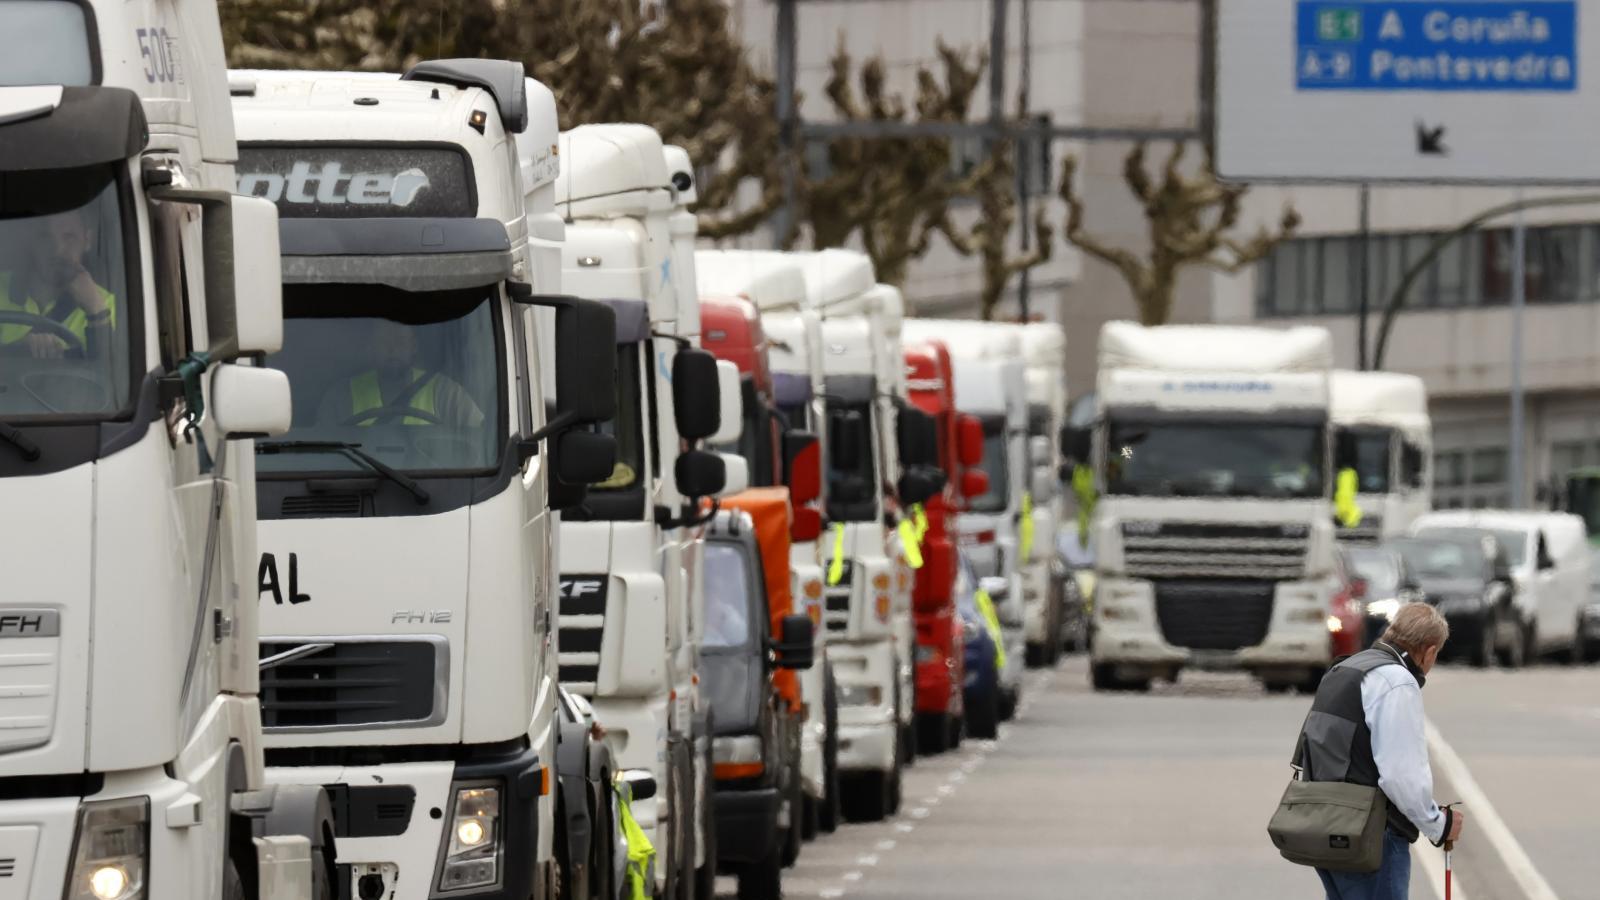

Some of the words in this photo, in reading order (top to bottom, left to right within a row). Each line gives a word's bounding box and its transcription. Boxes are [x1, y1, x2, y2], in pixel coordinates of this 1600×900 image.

[1379, 8, 1405, 40] A
[1423, 10, 1549, 43] Coruña
[136, 27, 174, 83] 500
[1370, 49, 1570, 81] Pontevedra
[235, 161, 430, 207] otter
[257, 552, 311, 605] AL
[0, 615, 42, 632] FH
